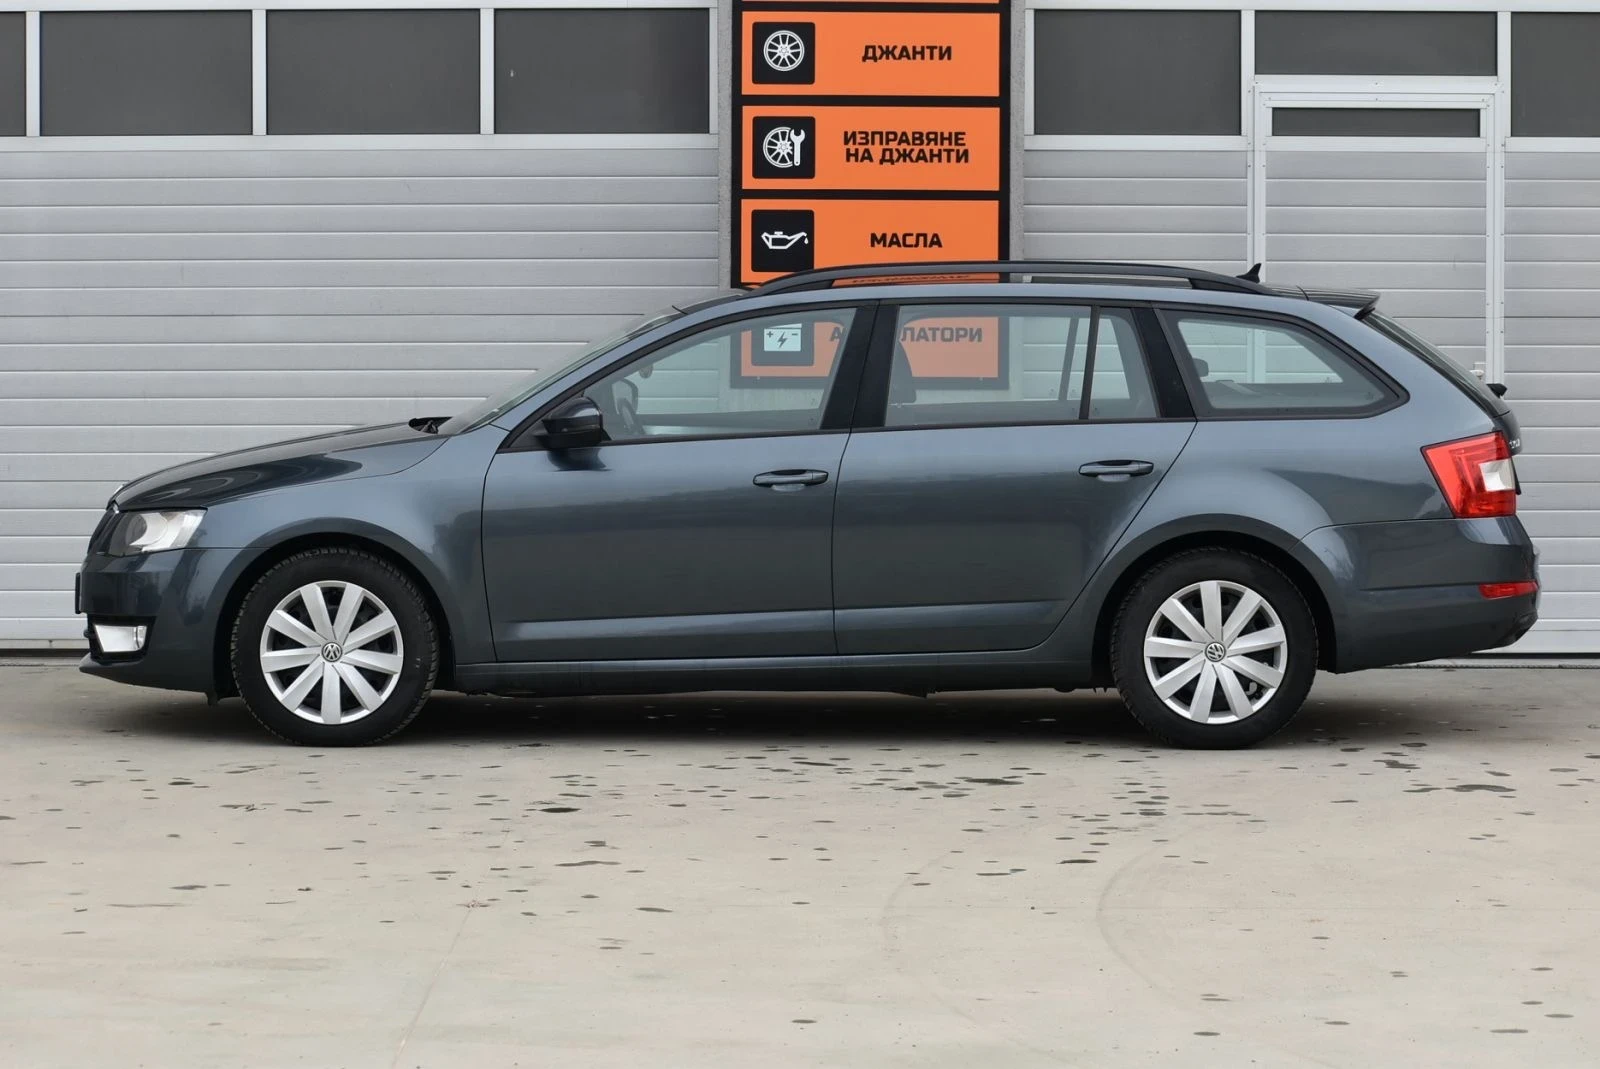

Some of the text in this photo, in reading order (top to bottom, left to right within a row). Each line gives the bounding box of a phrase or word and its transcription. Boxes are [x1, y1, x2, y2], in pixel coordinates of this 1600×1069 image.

[862, 45, 952, 62] ДЖАНТИ
[843, 131, 966, 146] ИЗПРАВЯНЕ
[845, 148, 970, 164] НА ДЖАНТИ
[870, 233, 943, 248] МАСЛА
[830, 327, 983, 342] АЛАТОРИ
